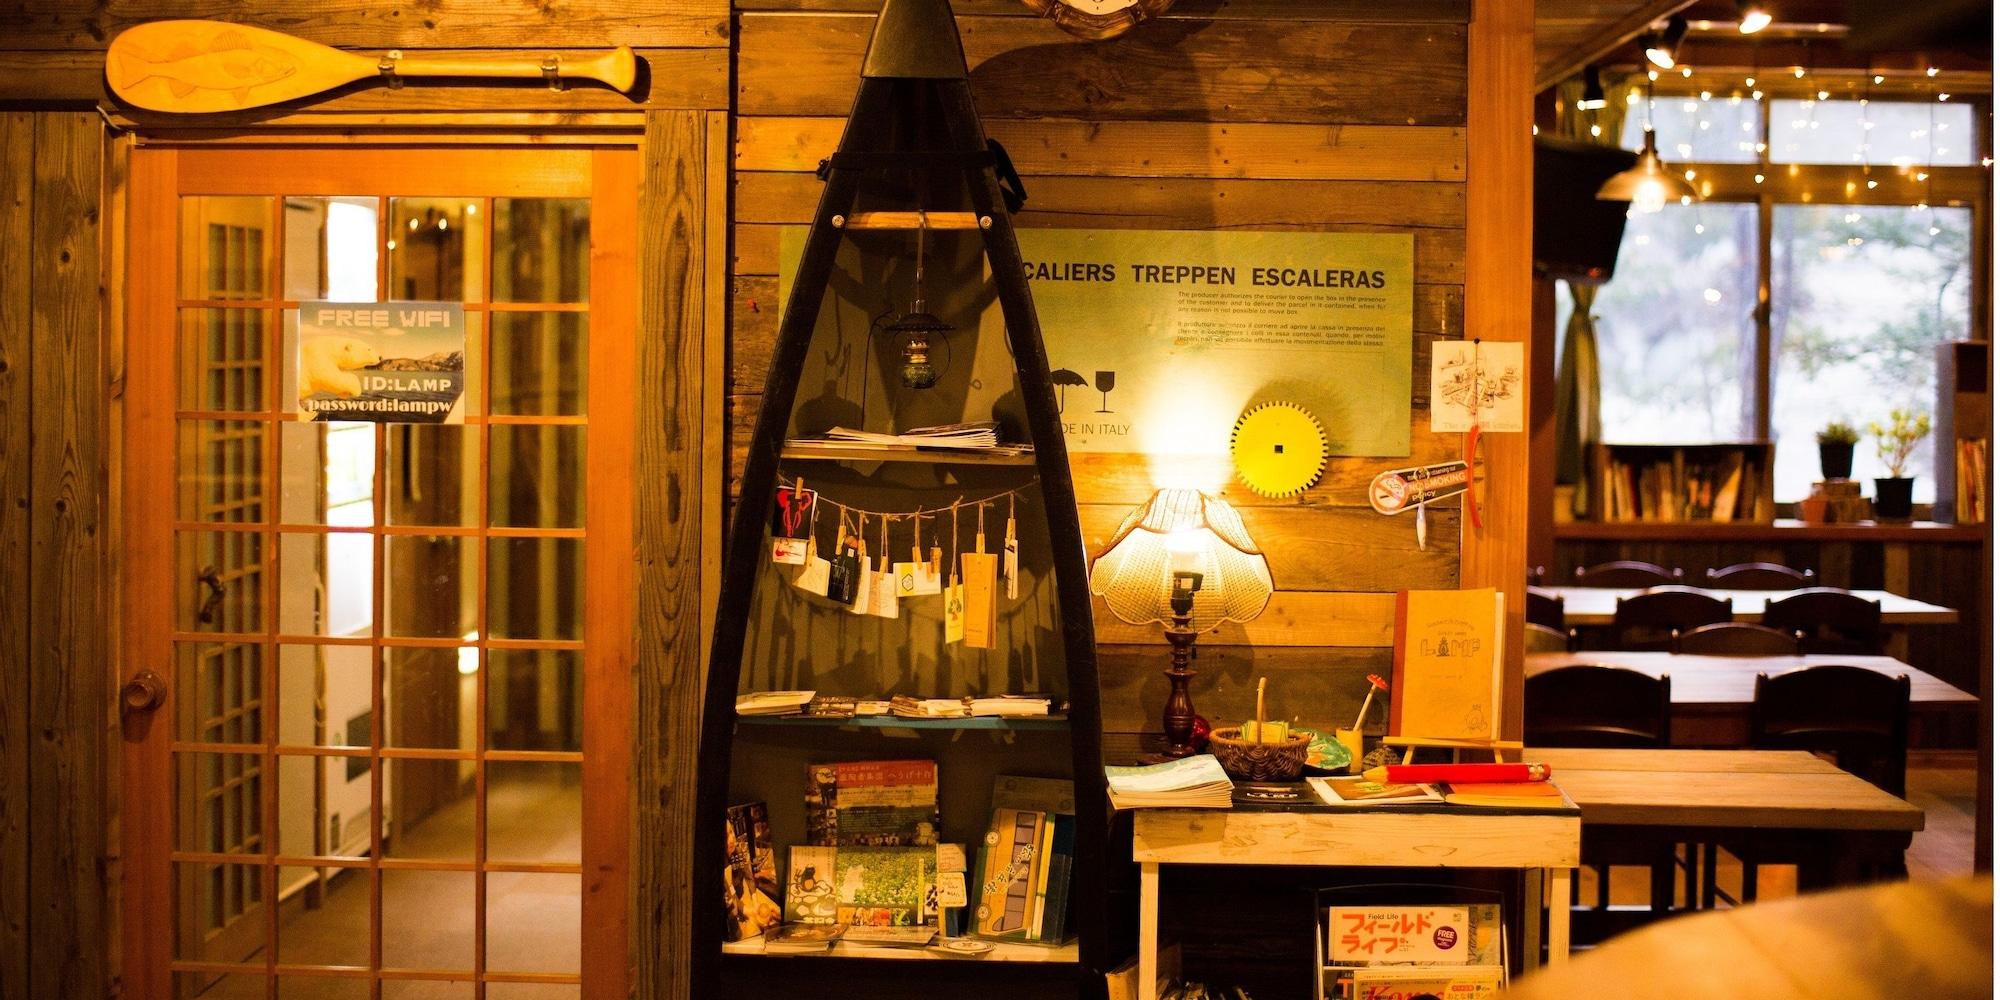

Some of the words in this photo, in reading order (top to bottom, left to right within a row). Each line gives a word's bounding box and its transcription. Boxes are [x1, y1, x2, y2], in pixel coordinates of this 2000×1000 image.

[1131, 264, 1235, 285] TREPPEN
[1252, 267, 1386, 289] ESCALERAS
[1191, 291, 1219, 299] producer
[318, 309, 389, 327] FREE
[400, 310, 450, 328] WIFI
[363, 376, 452, 392] ID:LAMP
[308, 398, 453, 414] password:lampw
[1081, 424, 1094, 435] IN
[1099, 424, 1130, 436] ITALY
[1342, 911, 1435, 935] フィールド
[1438, 930, 1454, 938] FREE
